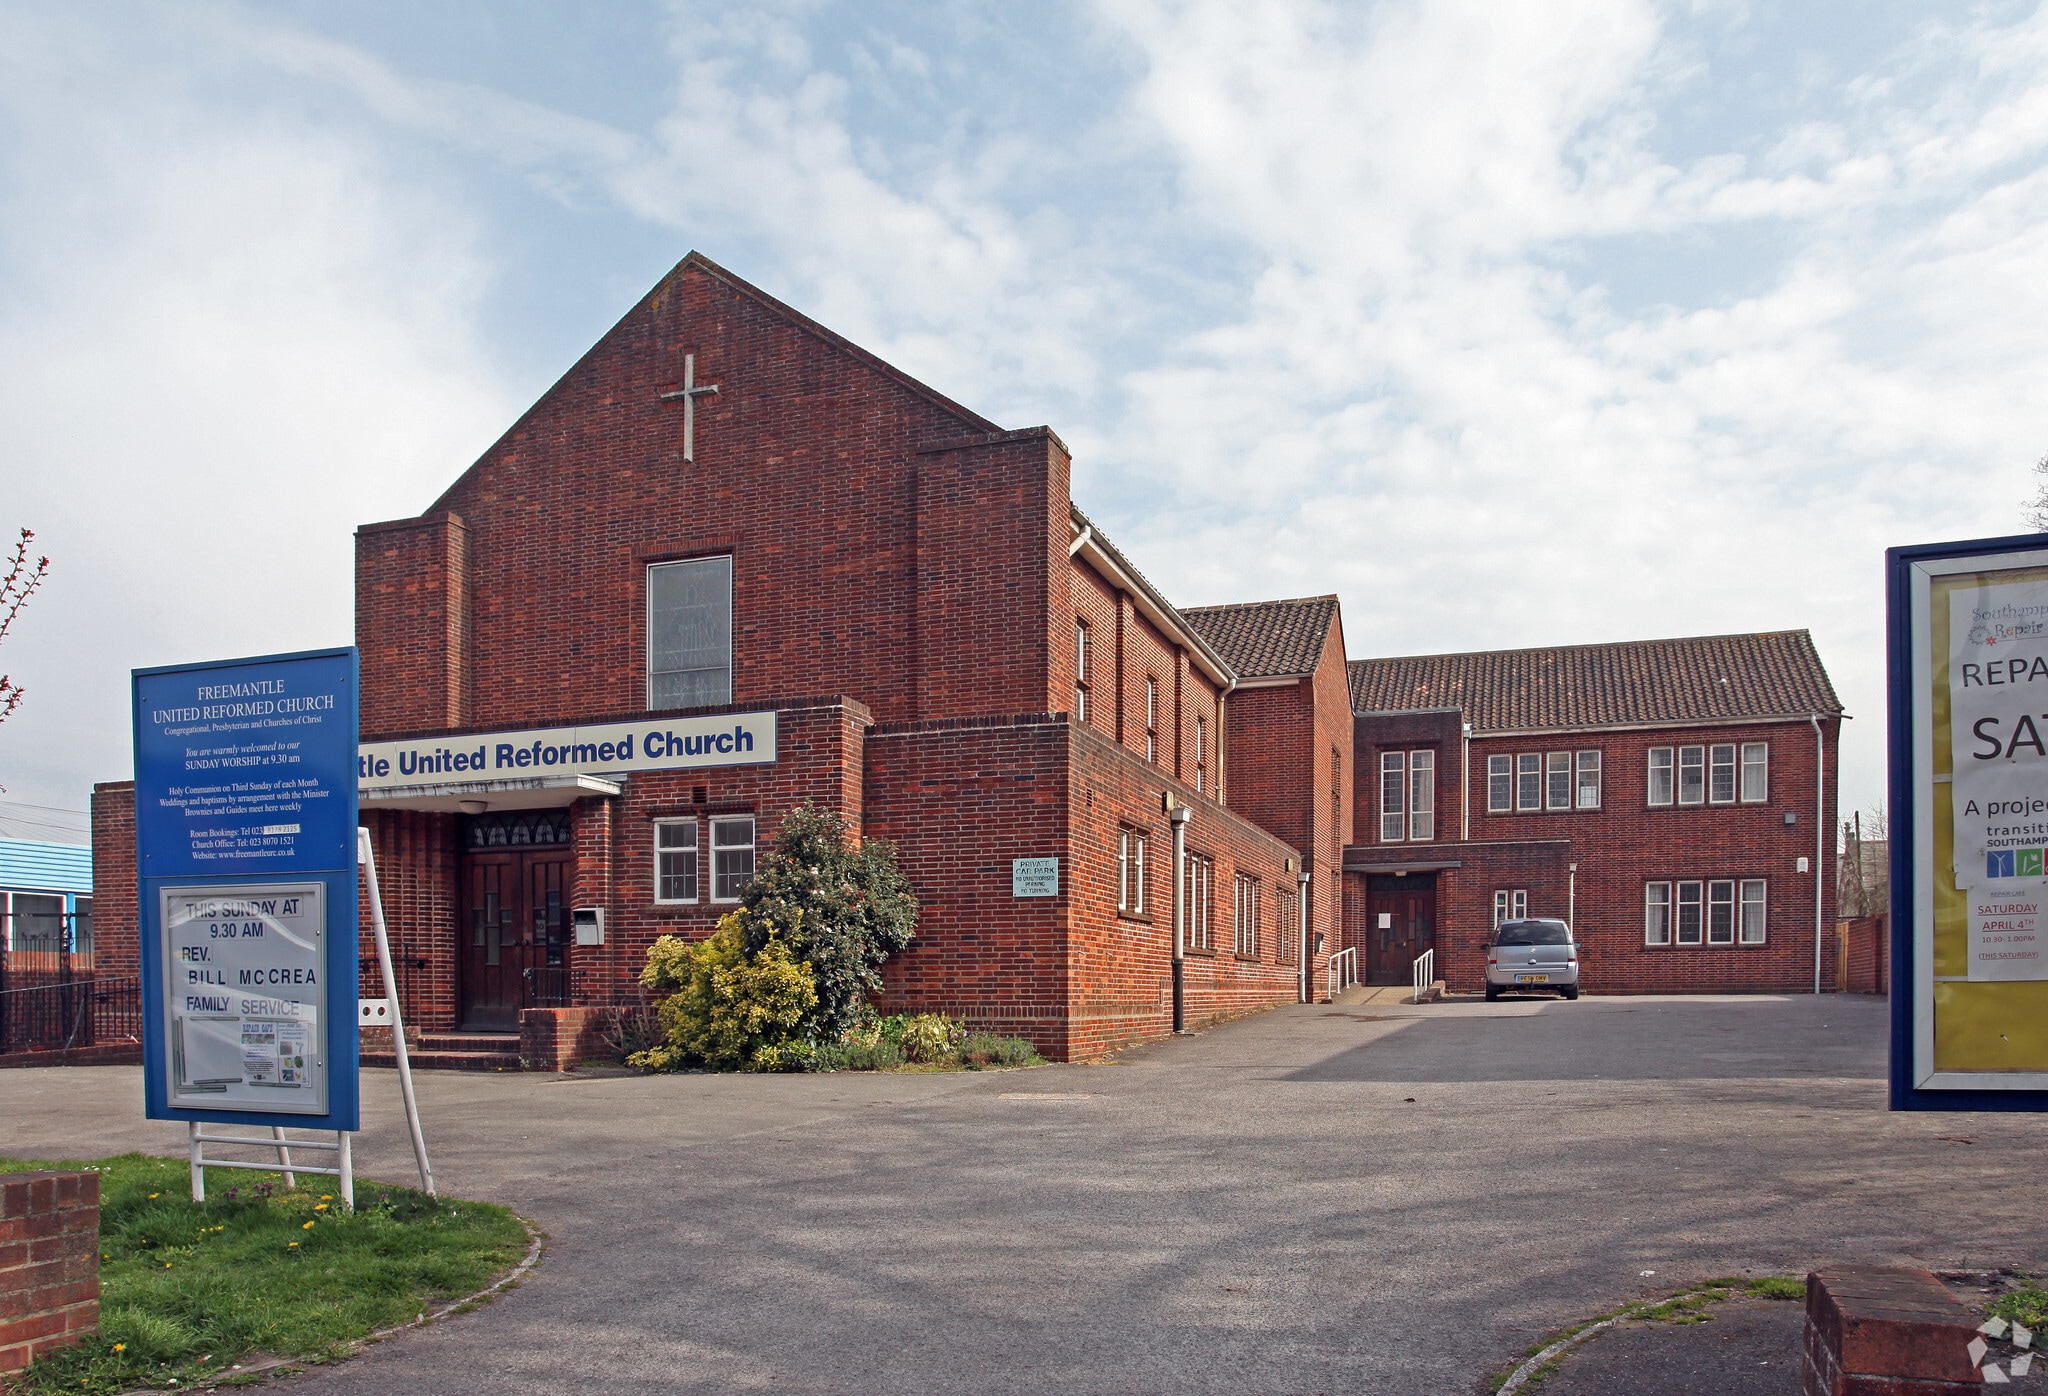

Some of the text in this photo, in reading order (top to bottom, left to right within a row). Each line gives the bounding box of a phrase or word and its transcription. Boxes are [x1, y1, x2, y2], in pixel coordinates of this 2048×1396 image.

[1994, 621, 2043, 639] Repair
[198, 679, 285, 701] FREEMANTLE
[153, 694, 335, 724] UNITED REFORMED CHURCH
[164, 714, 322, 736] Congregational, Presbyterian and Churches of Christ
[185, 748, 198, 757] You
[199, 748, 211, 756] are
[213, 744, 239, 756] warmly
[240, 741, 277, 753] welcomed
[278, 742, 285, 750] to
[399, 745, 486, 775] United
[496, 733, 634, 768] Reformed
[644, 725, 753, 757] Church
[185, 759, 220, 770] SUNDAY
[222, 756, 261, 767] WORSHIP
[262, 756, 270, 764] at
[271, 753, 287, 764] 9.30
[169, 787, 184, 796] Holy
[185, 785, 221, 795] Communion
[232, 782, 248, 792] Third
[249, 782, 272, 793] Sunday
[282, 780, 296, 788] each
[297, 778, 319, 787] Month
[159, 789, 329, 807] Weddings and baptisms by arrangement with the Minister
[185, 807, 213, 816] Brownies
[214, 807, 225, 815] and
[226, 805, 248, 814] Guides
[265, 804, 278, 812] here
[280, 802, 302, 812] weekly
[1964, 797, 2048, 819] A proje
[190, 829, 208, 838] Room
[209, 828, 239, 838] Bookings:
[241, 827, 250, 835] Tel
[251, 826, 263, 835] 023
[192, 836, 294, 848] Church Office: Tel: 023 8070 1521
[192, 847, 295, 859] Website: www.freemantleurc.co.uk
[186, 899, 299, 918] THIS SUNDAY AT
[1978, 904, 2038, 914] SATURDAY
[210, 922, 263, 938] 9.30 AM
[1982, 921, 2014, 930] APRIL
[182, 947, 211, 961] REV.
[188, 970, 226, 985] BILL
[187, 996, 299, 1015] FAMILY SERVICE
